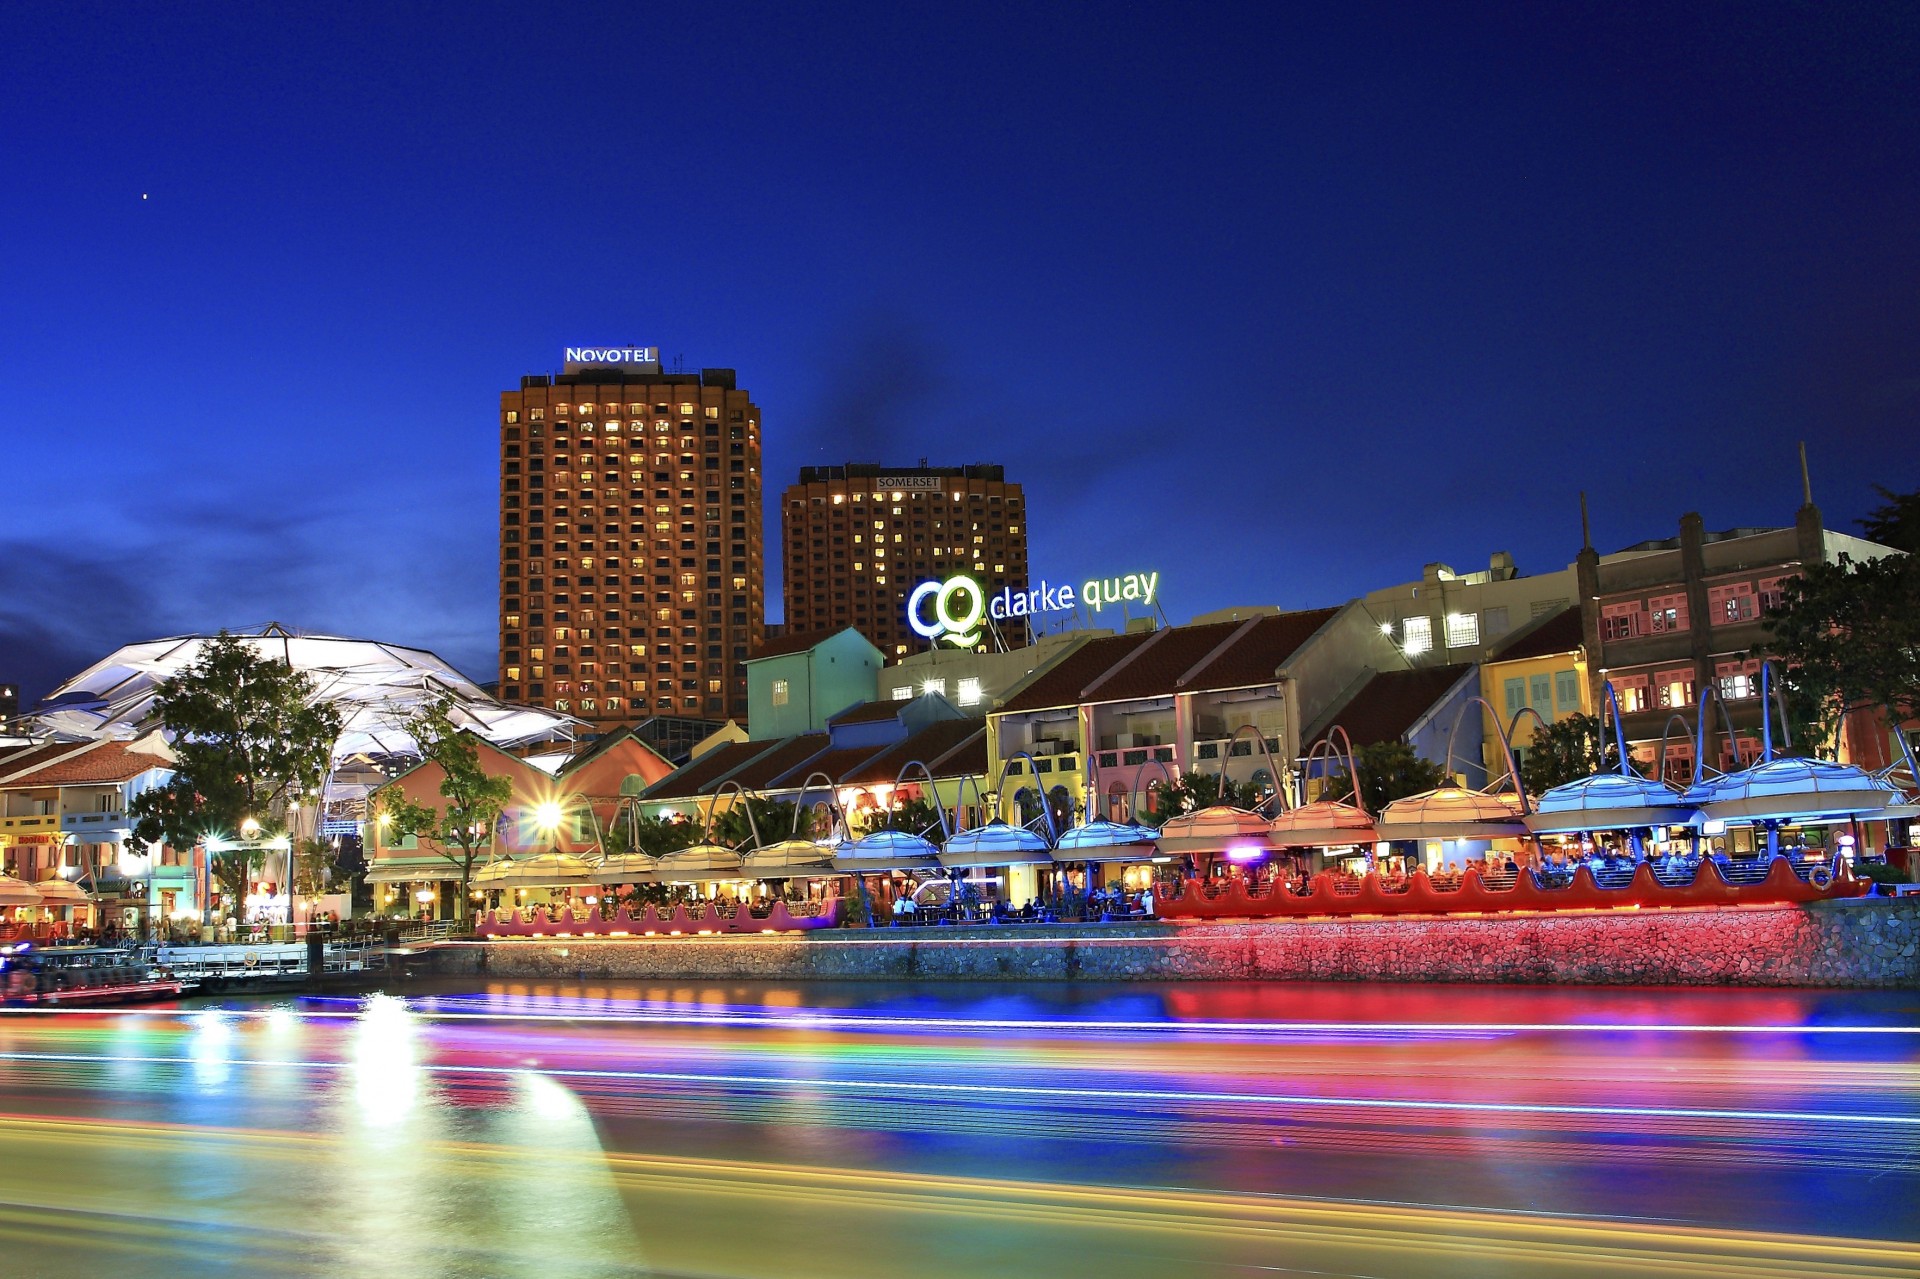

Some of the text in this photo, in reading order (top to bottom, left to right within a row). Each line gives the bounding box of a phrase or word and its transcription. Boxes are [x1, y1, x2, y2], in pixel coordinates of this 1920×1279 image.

[566, 347, 656, 362] NOVOTEL
[879, 477, 938, 487] SOMERSET
[990, 580, 1075, 619] clarke
[1082, 571, 1159, 613] quay
